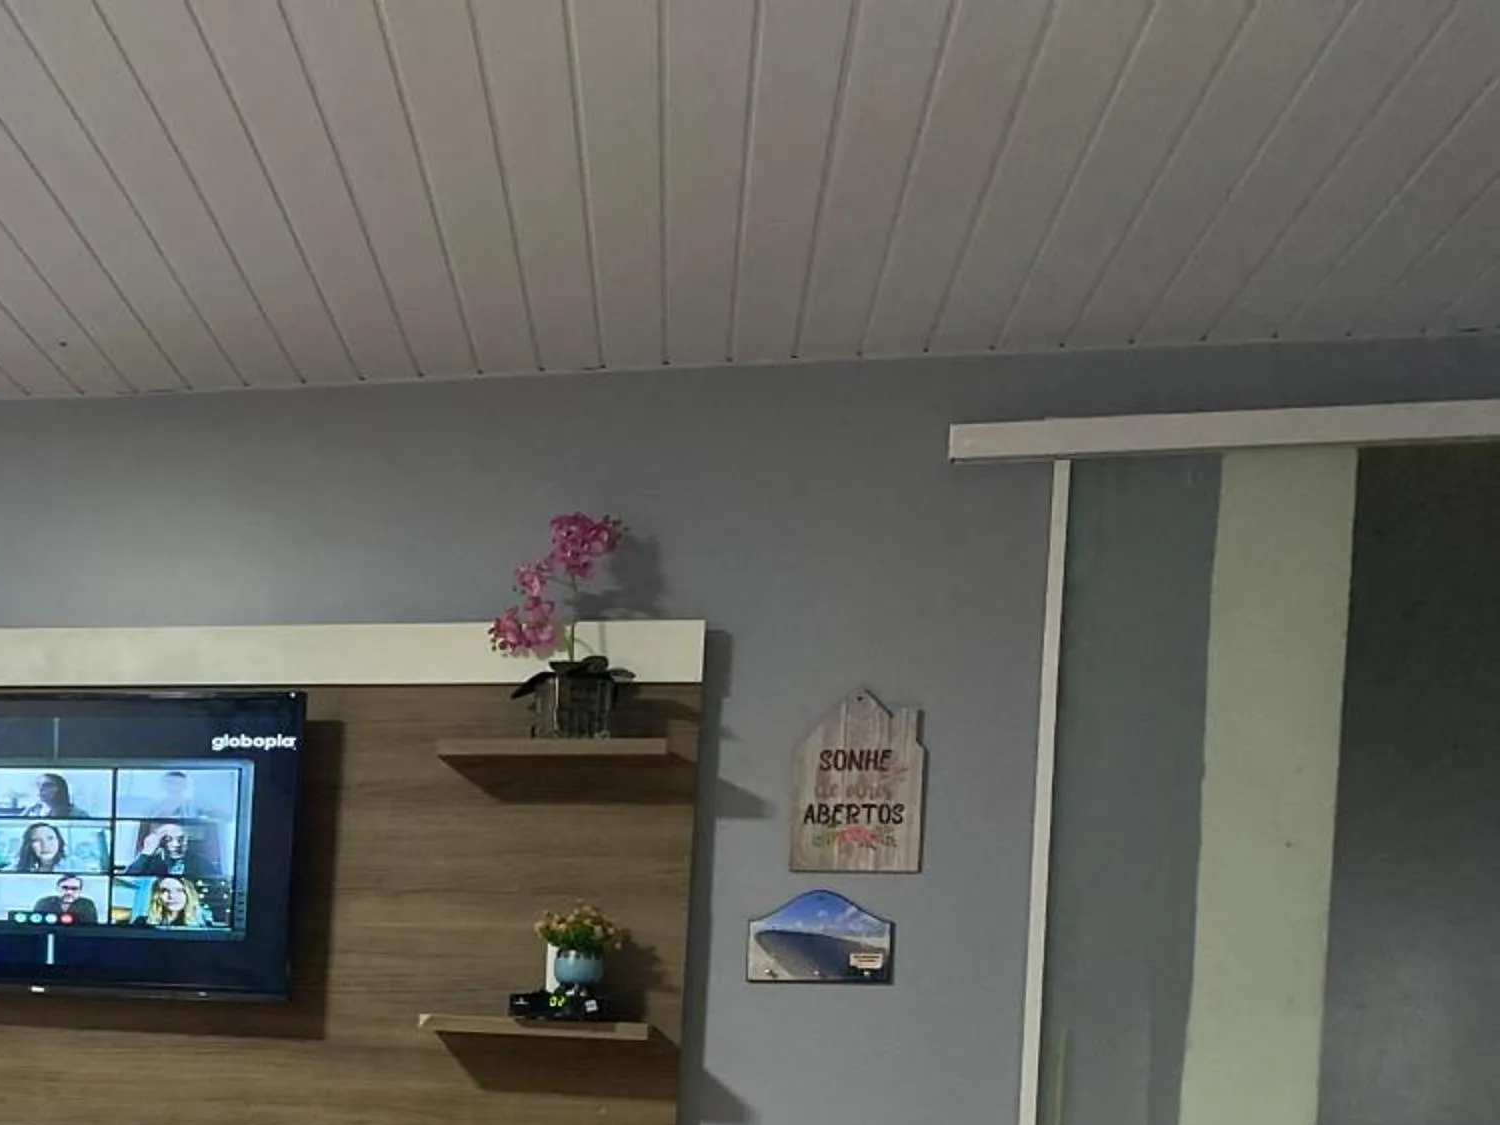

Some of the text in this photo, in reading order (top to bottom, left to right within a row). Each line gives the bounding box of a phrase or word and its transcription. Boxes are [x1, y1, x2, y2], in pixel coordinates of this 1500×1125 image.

[211, 733, 298, 751] globopla
[819, 749, 893, 771] SONHE
[803, 803, 905, 825] ABERTOS
